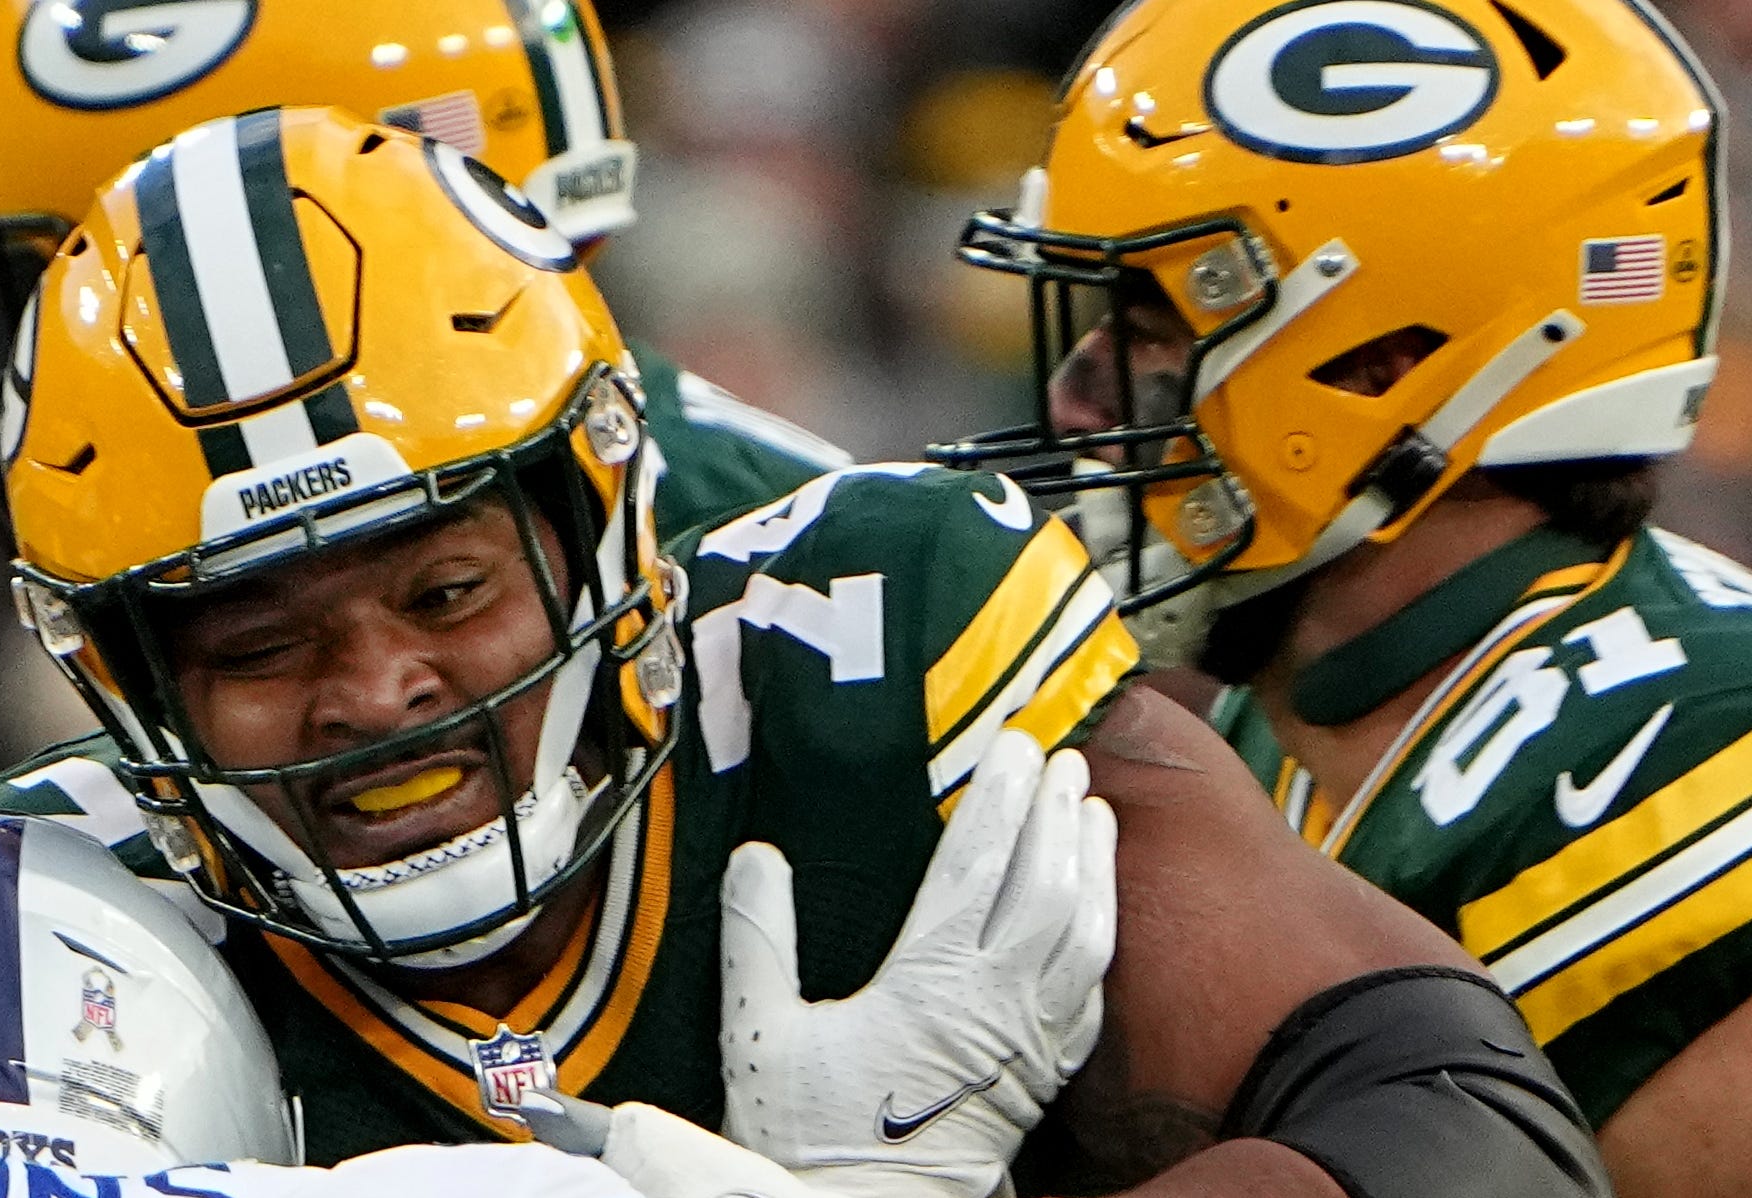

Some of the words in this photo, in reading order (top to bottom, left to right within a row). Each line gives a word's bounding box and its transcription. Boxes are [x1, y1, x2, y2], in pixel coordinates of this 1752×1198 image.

[1208, 0, 1493, 152] G
[239, 456, 352, 519] PACKERS
[85, 1003, 114, 1026] NFL
